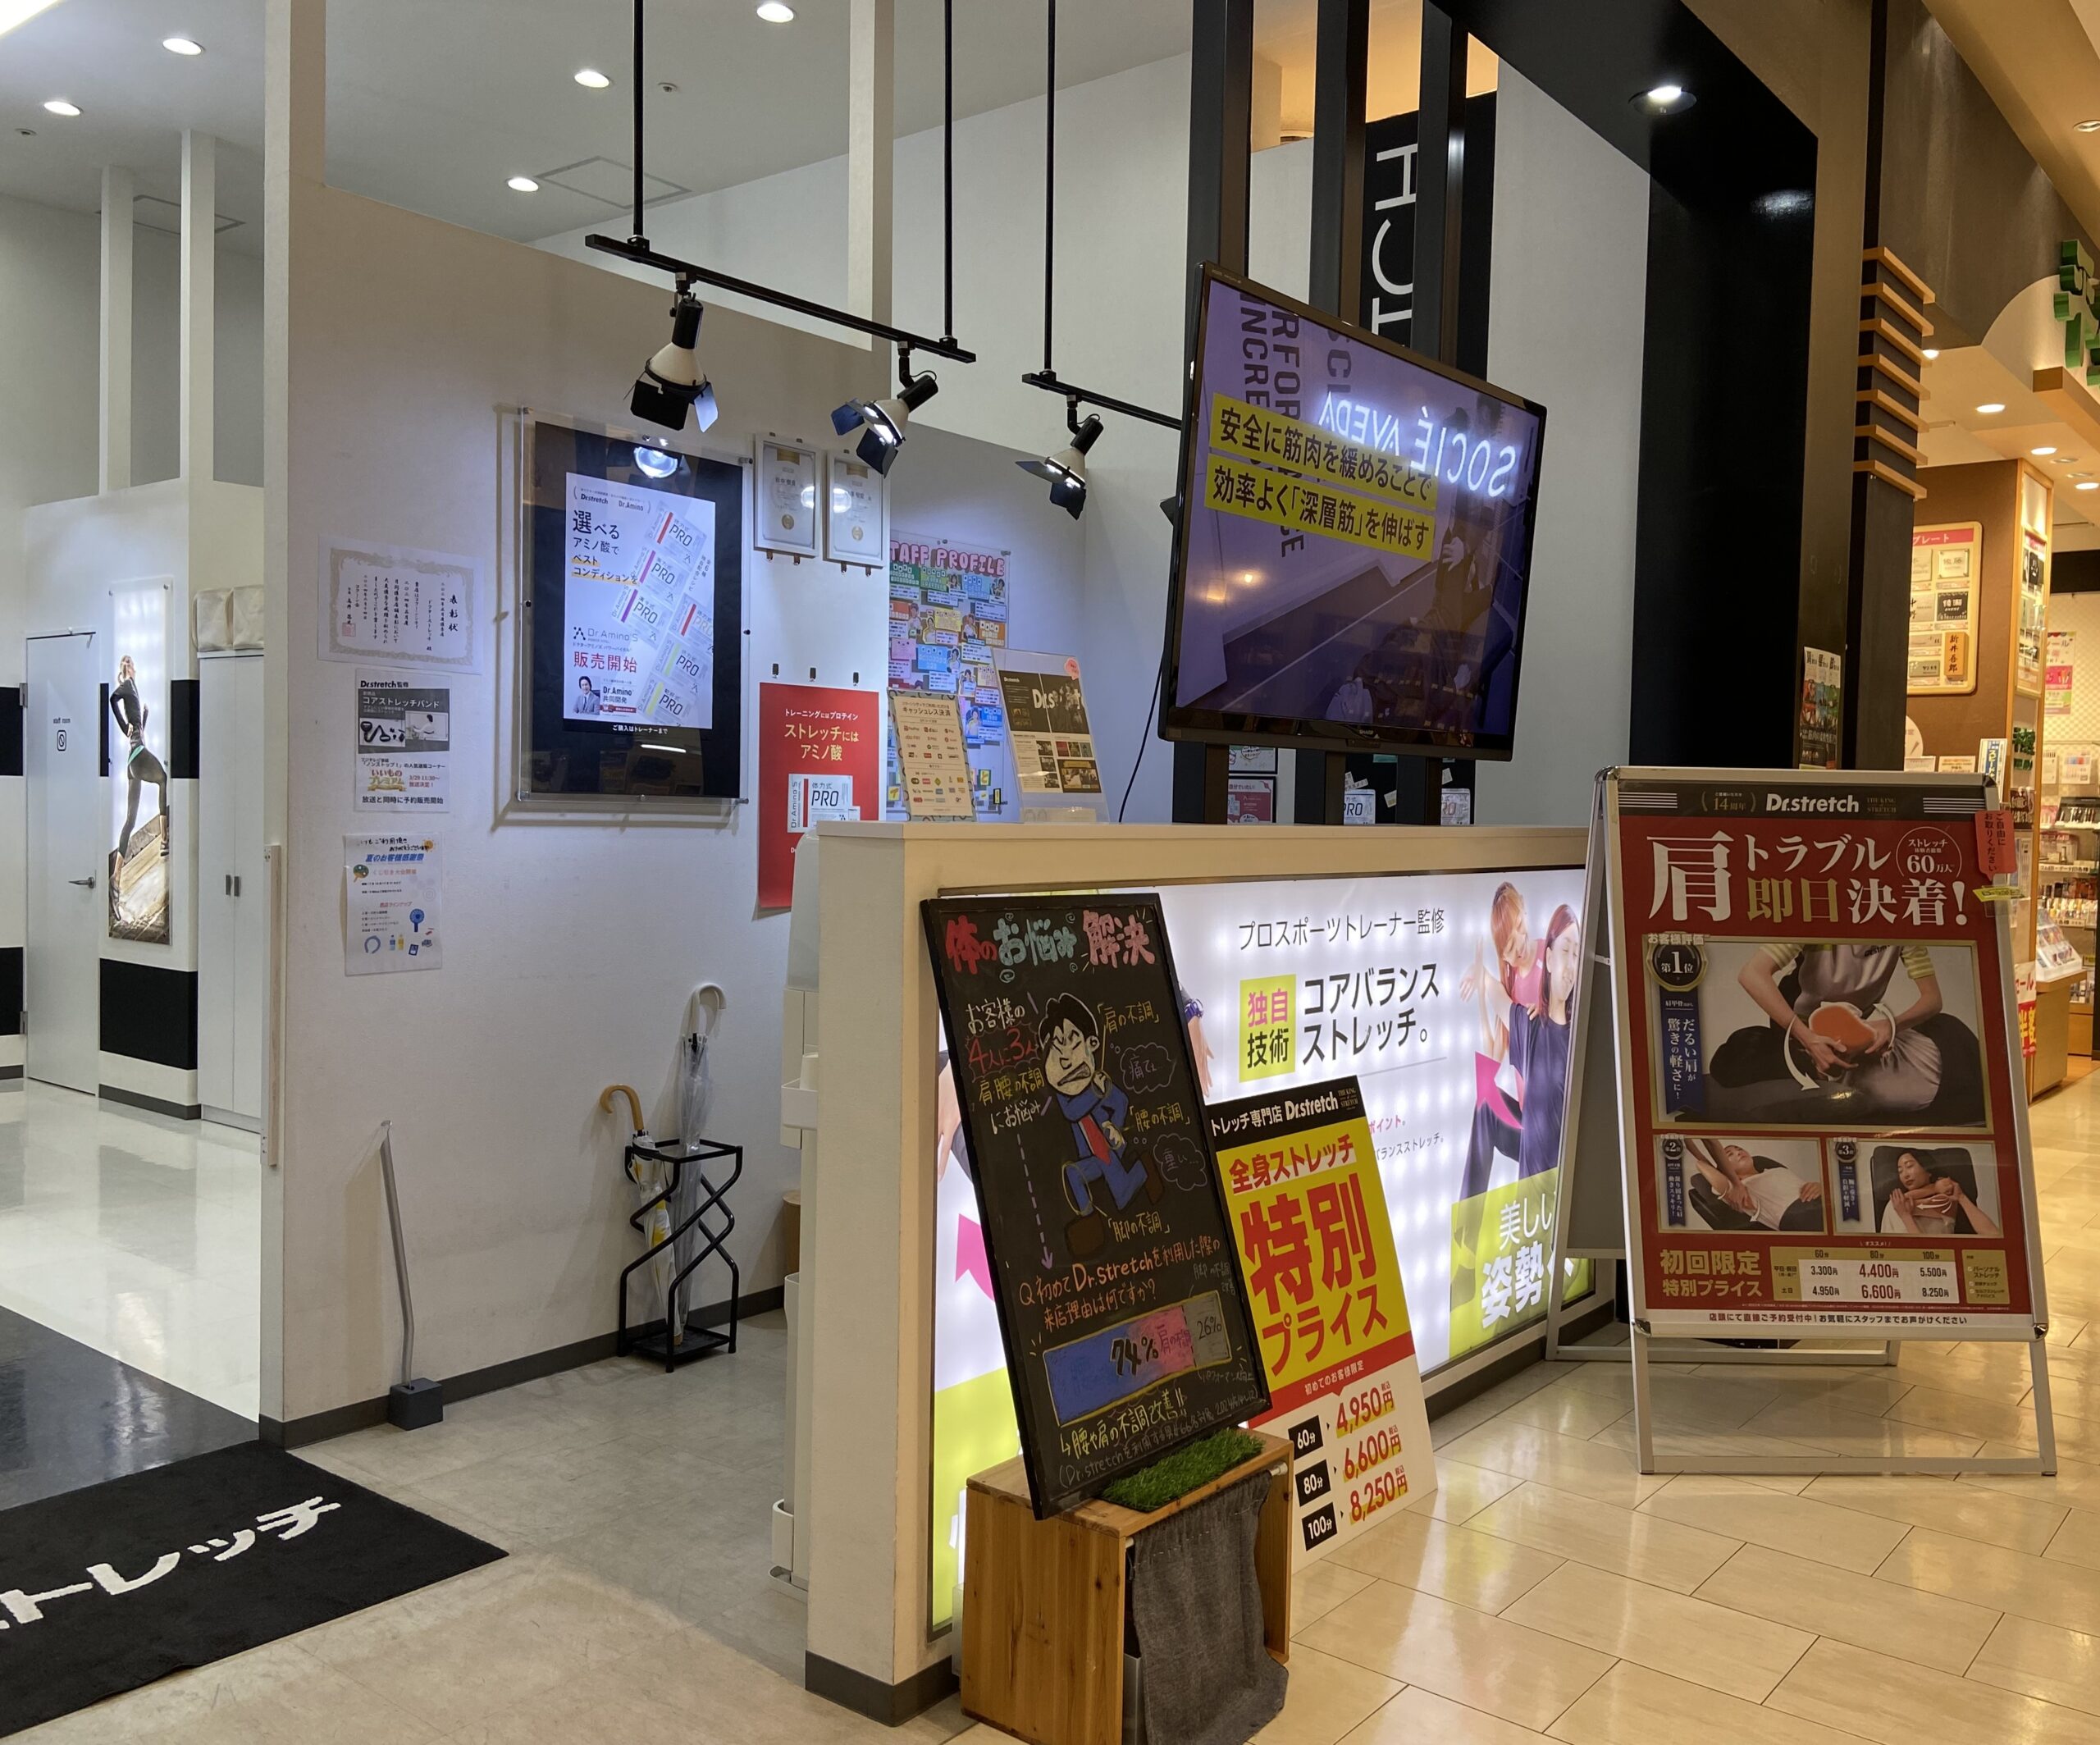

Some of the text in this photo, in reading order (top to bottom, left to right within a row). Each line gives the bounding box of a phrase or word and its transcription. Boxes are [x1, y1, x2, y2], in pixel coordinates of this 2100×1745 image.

[1221, 407, 1431, 501] 安全に筋肉を緩めることで
[1212, 465, 1429, 550] 効率よく「深層筋」を伸ばす
[573, 509, 620, 540] 選べる
[669, 524, 692, 546] PRO
[573, 537, 619, 555] アミノ酸で
[573, 555, 598, 564] ベスト
[573, 567, 638, 585] コンディションを
[651, 563, 675, 585] PRO
[936, 547, 1005, 577] PROFILE
[449, 594, 459, 632] 表彰状
[633, 602, 657, 624] PRO
[573, 651, 637, 673] 販売開始
[676, 655, 700, 677] PRO
[363, 697, 440, 709] コアストレッチバンド
[660, 694, 683, 715] PRO
[785, 709, 858, 720] トレーニングにはプロテイン
[613, 724, 669, 734] ご購入はトレーナーまで
[784, 724, 859, 742] ストレッチには
[801, 744, 842, 761] アミノ酸
[362, 795, 444, 805] 放送と同時に予約販売開始
[811, 790, 838, 806] PRO
[1766, 793, 1859, 812] Dr.stretch
[1908, 838, 1948, 847] ストレッチ
[1985, 813, 1997, 871] お取りください
[1997, 812, 2006, 846] ご自由に
[1646, 829, 1892, 922] 肩 トラブル
[1907, 854, 1952, 874] 60万人
[1239, 907, 1445, 952] プロスポーツトレーナー監修
[1648, 934, 1704, 945] お客様評価
[1661, 951, 1694, 974] 第1位
[1303, 962, 1440, 1016] コアバランス
[966, 998, 1025, 1035] お客様の
[1097, 1001, 1161, 1034] 「肩の不調」
[1247, 988, 1289, 1028] 独自
[969, 1027, 1038, 1073] 4人に3人
[1247, 1027, 1289, 1069] 技術
[1302, 1007, 1428, 1066] ストレッチ。
[1683, 1019, 1697, 1081] だるい肩が
[990, 1099, 1041, 1135] にお悩み
[1129, 1102, 1190, 1132] 「腰の不調」
[1285, 1091, 1339, 1121] Dr.stretch
[1229, 1134, 1354, 1195] 全身ストレッチ
[1107, 1211, 1171, 1244] 「脚の不調」
[1239, 1172, 1377, 1316] 特別
[1659, 1249, 1762, 1276] 初回限定
[1662, 1278, 1763, 1299] 特別プライス
[1197, 1316, 1222, 1340] 26%
[1262, 1283, 1388, 1377] プライス
[1110, 1336, 1159, 1377] 74%
[1304, 1359, 1365, 1396] 初めてのお客様限定
[1297, 1428, 1316, 1450] 60分
[1336, 1387, 1395, 1434] 4,950円
[1303, 1473, 1323, 1495] 80分
[1344, 1430, 1402, 1481] 6,600円
[1308, 1516, 1332, 1540] 100分
[1349, 1471, 1408, 1522] 8,250円
[0, 1496, 340, 1629] トレッチ
